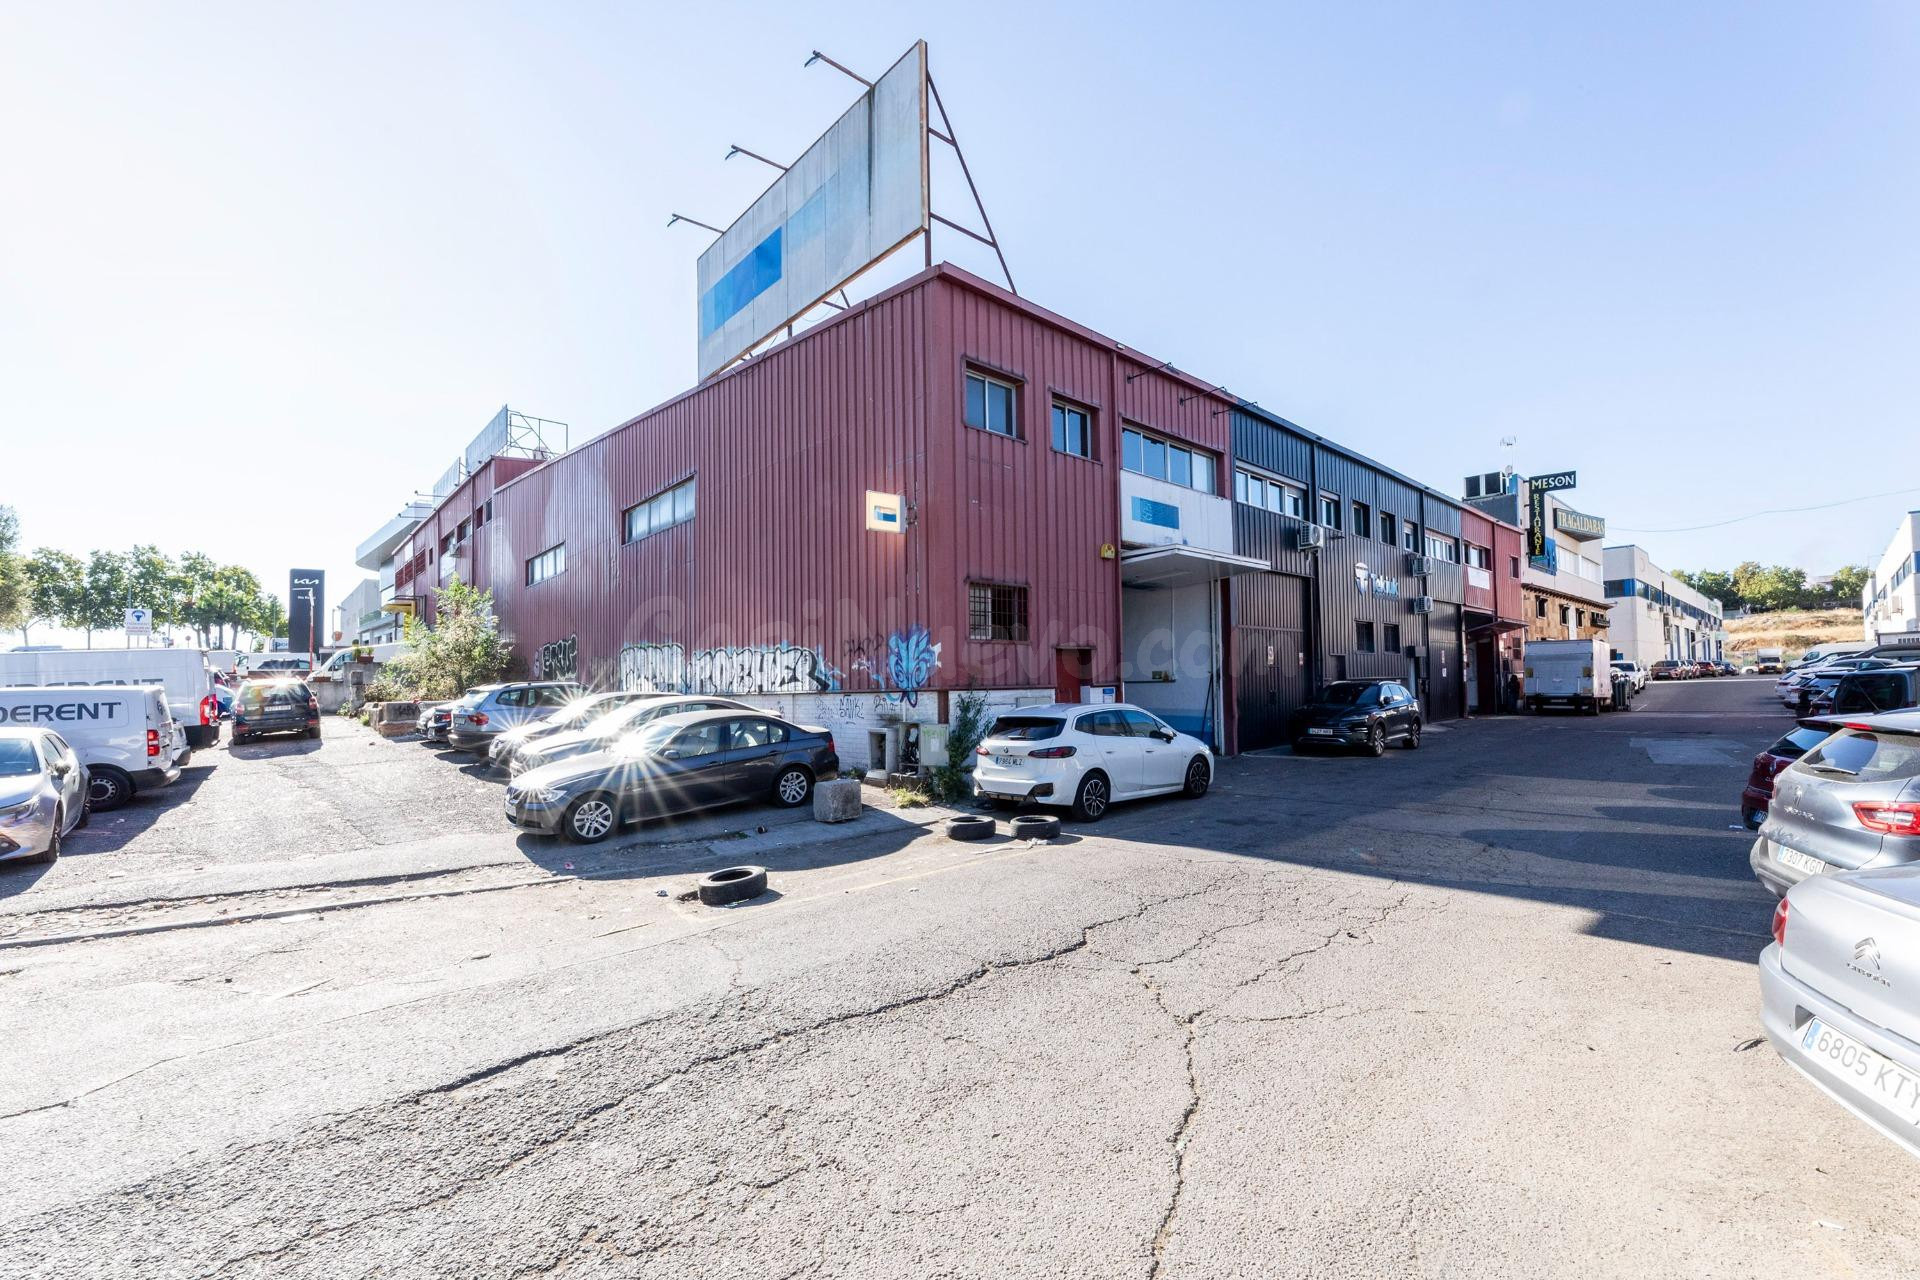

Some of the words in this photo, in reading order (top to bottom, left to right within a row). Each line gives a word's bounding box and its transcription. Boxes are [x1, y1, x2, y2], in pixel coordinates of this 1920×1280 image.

[1531, 474, 1575, 490] MESON
[1533, 493, 1542, 555] RESTAURANTE
[1558, 511, 1605, 535] TRAGALDABAS
[1784, 848, 1804, 866] 7307
[1818, 1031, 1871, 1076] 6805
